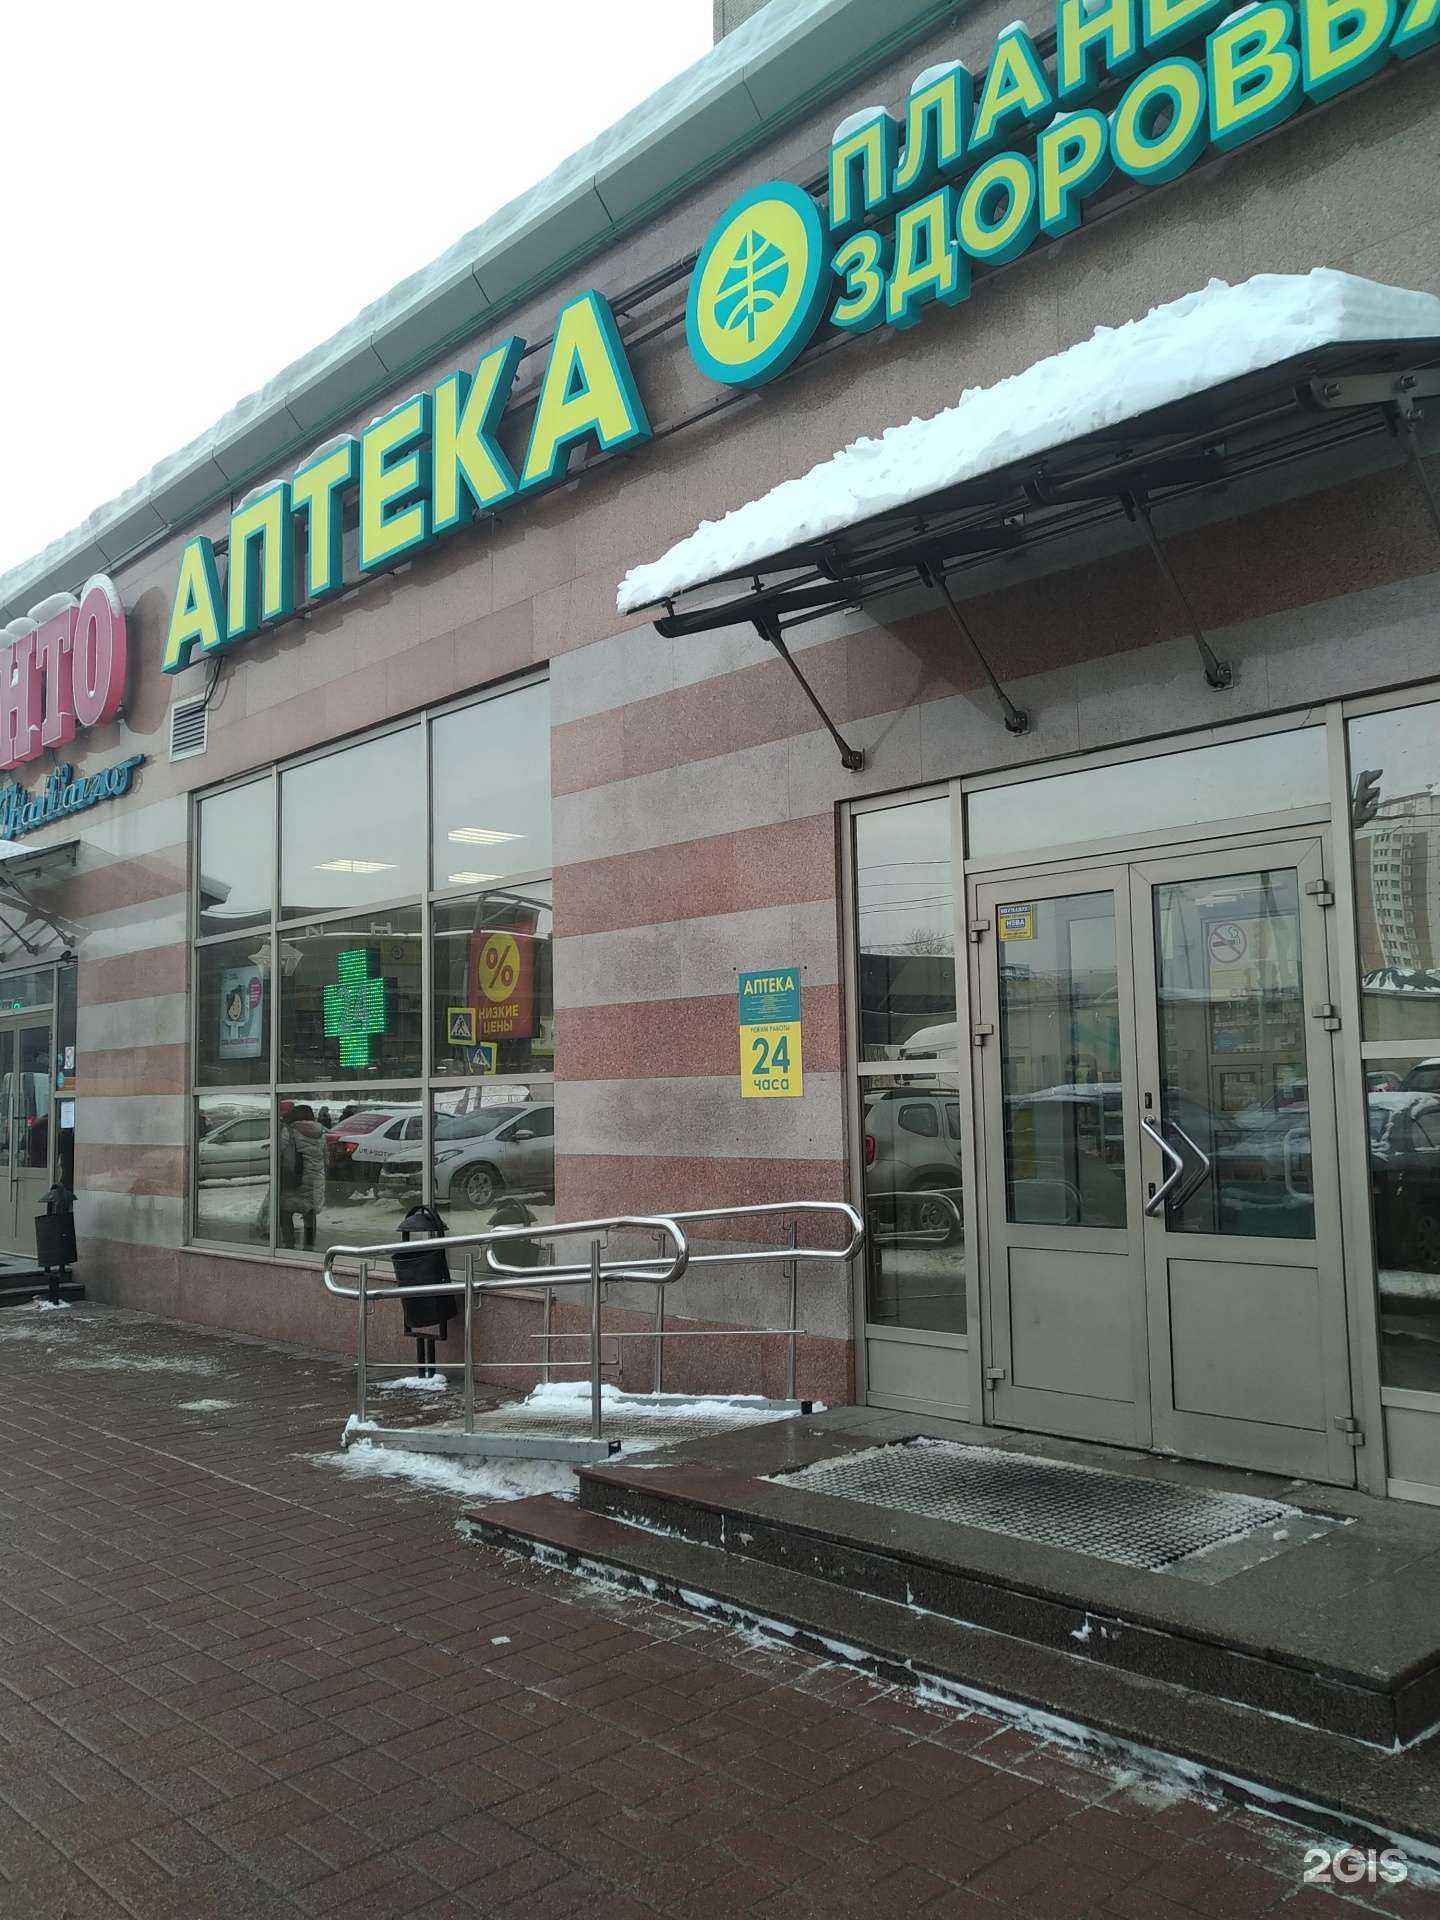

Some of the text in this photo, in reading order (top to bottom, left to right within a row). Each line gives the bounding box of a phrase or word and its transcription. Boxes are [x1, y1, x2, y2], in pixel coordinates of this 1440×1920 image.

[161, 288, 653, 675] АПТЕКА
[743, 975, 795, 996] АПТЕКА
[478, 1004, 520, 1019] НИЗКИЕ
[483, 1019, 513, 1034] ЦЕНЫ
[751, 1035, 791, 1075] 24
[753, 1078, 790, 1091] часа
